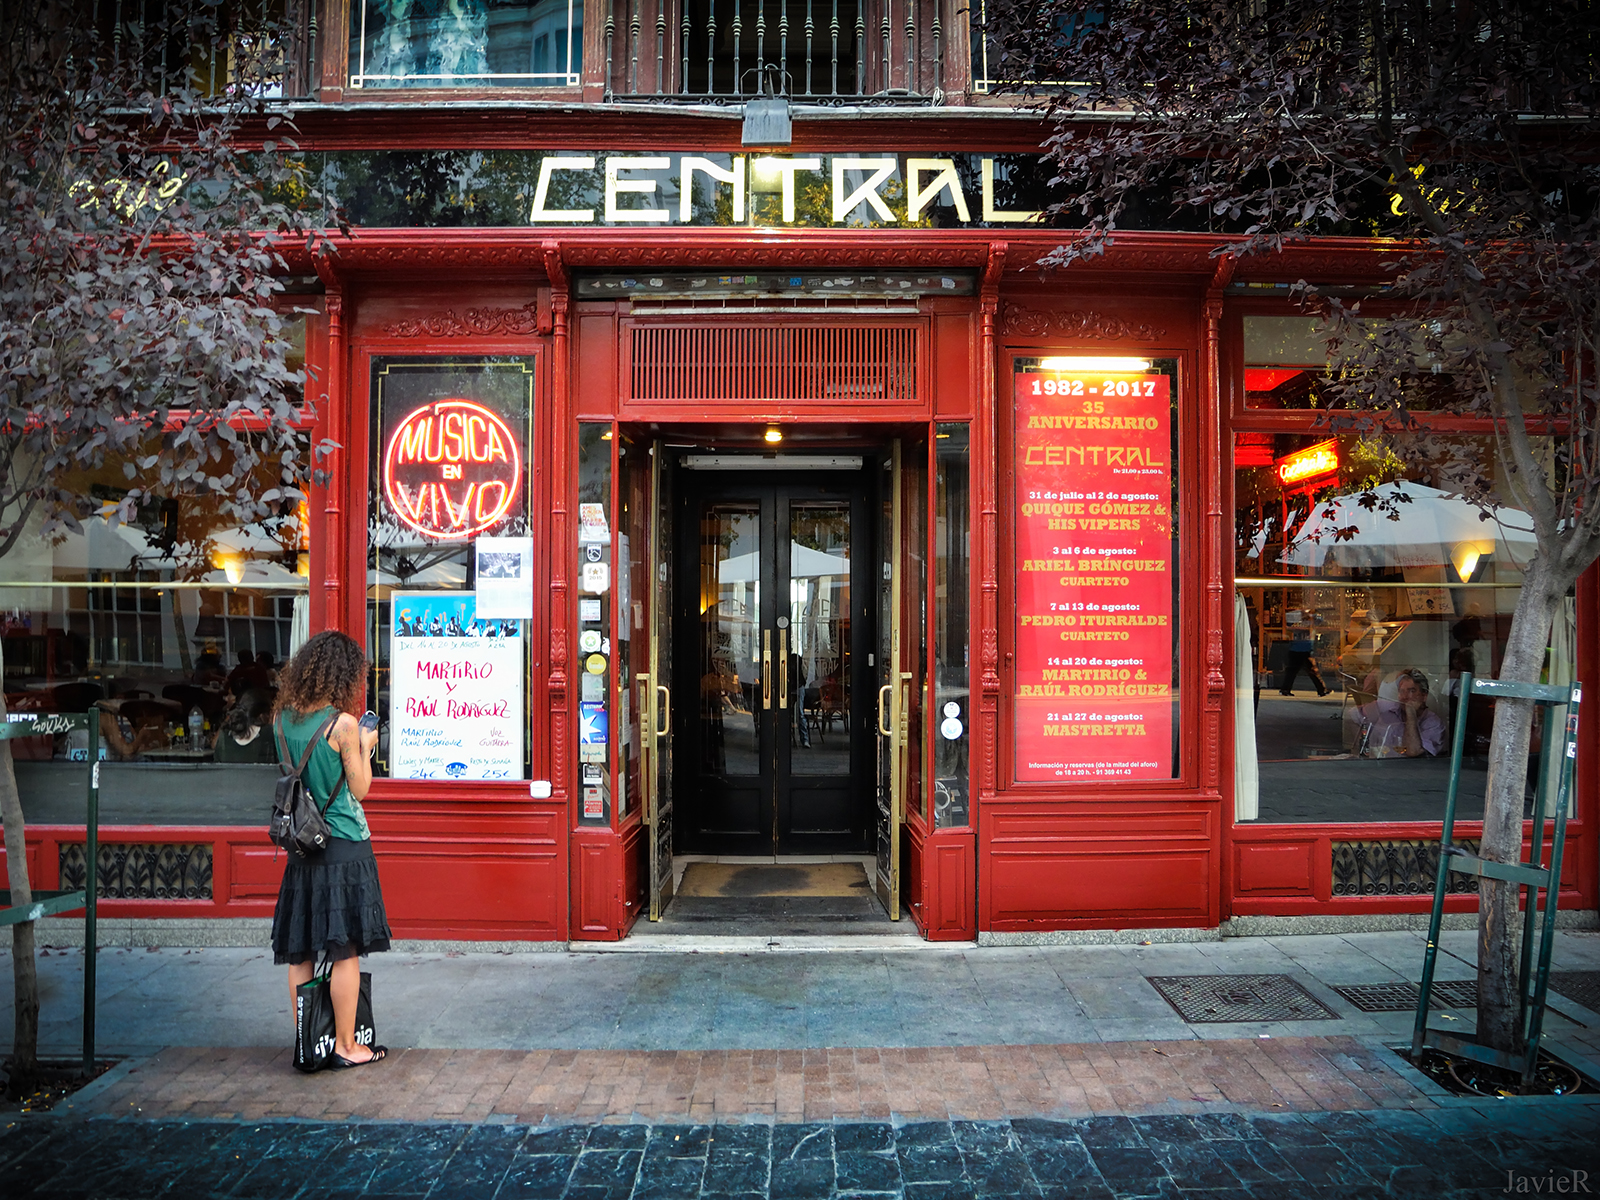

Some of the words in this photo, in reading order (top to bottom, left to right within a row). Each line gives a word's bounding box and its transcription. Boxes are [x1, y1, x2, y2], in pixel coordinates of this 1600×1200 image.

[530, 157, 1046, 222] CENTRAL
[1032, 380, 1084, 396] 1982
[1102, 381, 1156, 396] 2017
[1082, 401, 1104, 414] 35
[1028, 416, 1158, 430] ANIVERSARIO
[1025, 446, 1164, 466] CENTRAL
[442, 464, 462, 479] EN
[1059, 492, 1084, 502] julio
[1121, 493, 1159, 502] agosto:
[396, 480, 506, 528] VIVO
[1021, 503, 1084, 517] QUIQUE
[1088, 501, 1150, 515] GÓMEZ
[1154, 504, 1166, 515] &
[1048, 519, 1076, 530] HIS
[1078, 519, 1140, 530] VIPERS
[1098, 547, 1136, 556] agosto:
[1022, 560, 1074, 571] ARIEL
[1078, 557, 1165, 572] BRÍNGUEZ
[1060, 577, 1129, 586] CUARTETO
[1102, 603, 1140, 613] agosto:
[1021, 616, 1076, 626] PEDRO
[1080, 616, 1167, 626] ITURRALDE
[1060, 632, 1129, 640] CUARTETO
[1105, 658, 1143, 668] agosto:
[1042, 669, 1130, 680] MARTIRIO
[1135, 669, 1147, 680] &
[1020, 682, 1065, 696] RAÚL
[1069, 682, 1168, 696] RODRÍGUEZ
[1105, 714, 1143, 723] agosto:
[1043, 725, 1146, 736] MASTRETTA
